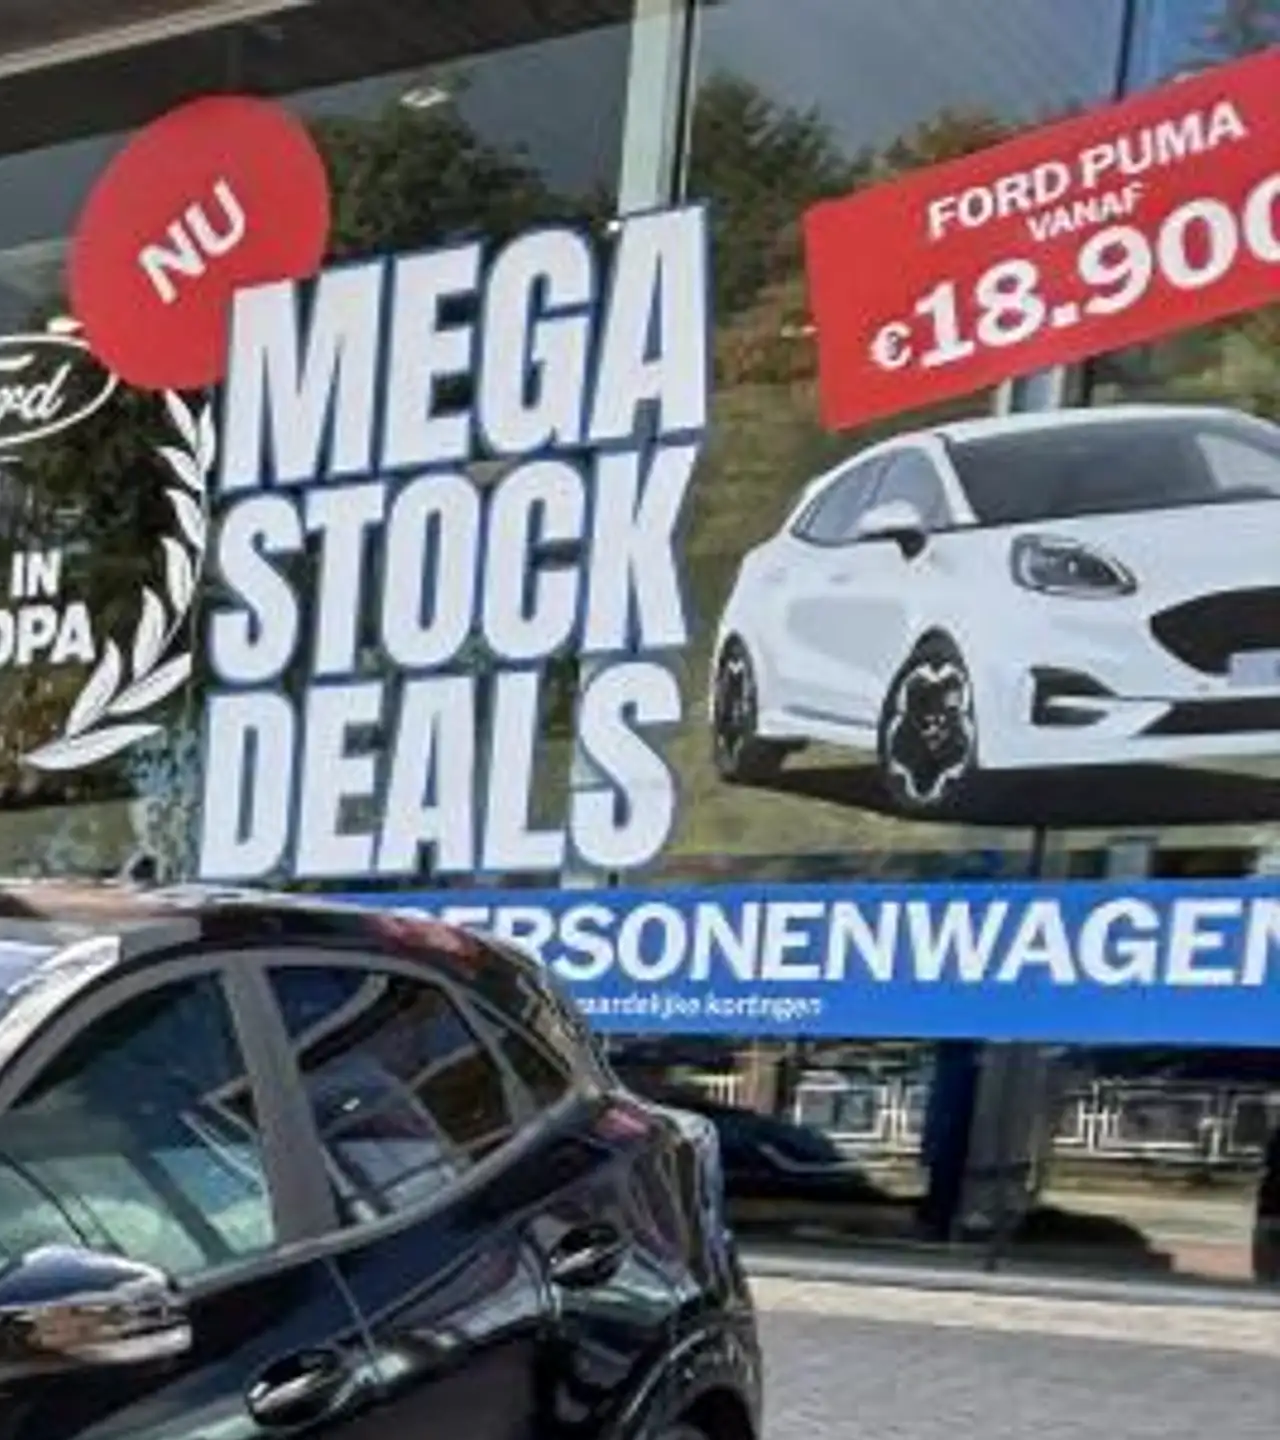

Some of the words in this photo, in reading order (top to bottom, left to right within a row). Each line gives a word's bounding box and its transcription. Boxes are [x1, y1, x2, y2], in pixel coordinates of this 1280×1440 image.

[135, 180, 246, 302] NU
[927, 163, 1071, 243] FORD
[1080, 101, 1247, 187] PUMA
[1027, 182, 1145, 242] VANAF
[221, 206, 707, 489] MEGA
[11, 550, 62, 598] IN
[207, 446, 698, 684] STOCK
[197, 663, 683, 880] DEALS
